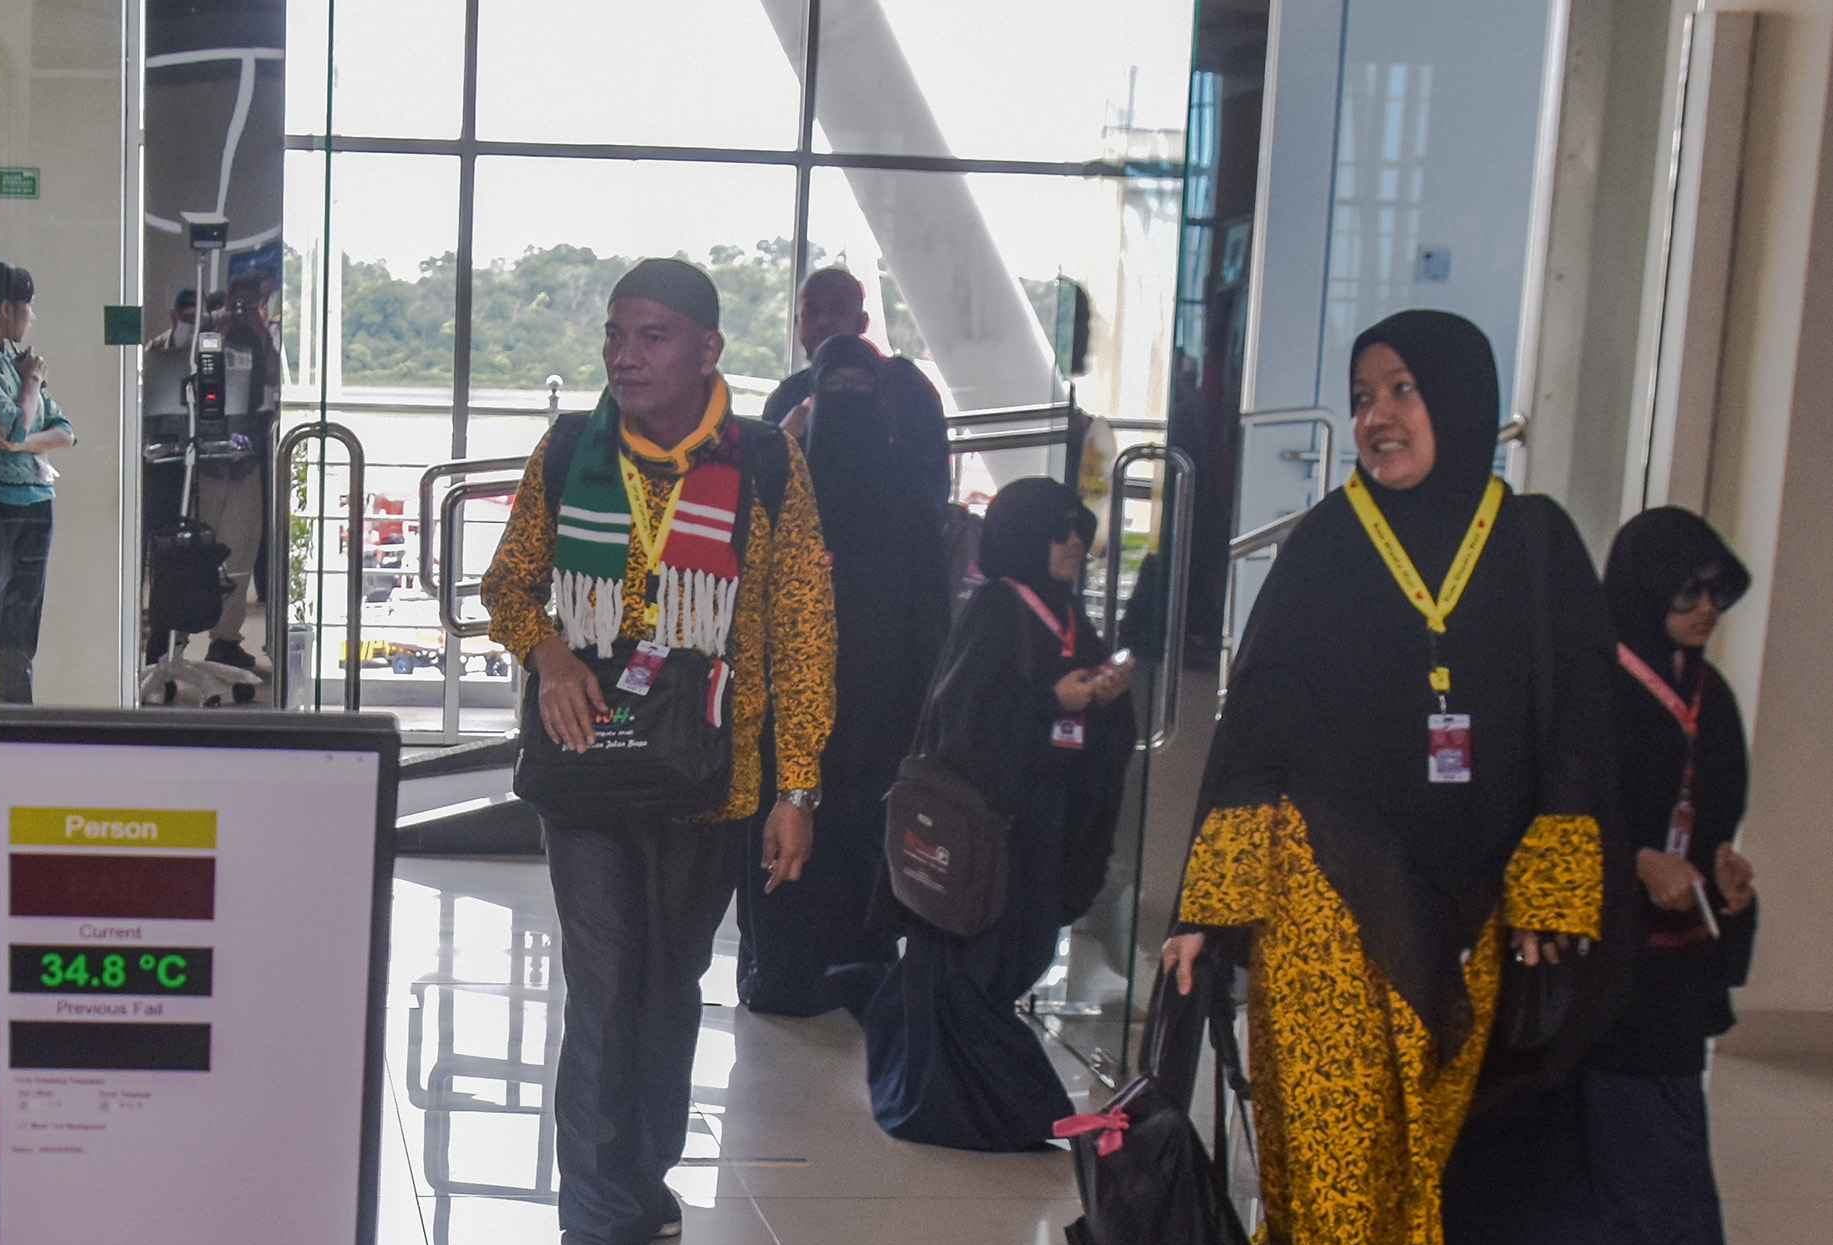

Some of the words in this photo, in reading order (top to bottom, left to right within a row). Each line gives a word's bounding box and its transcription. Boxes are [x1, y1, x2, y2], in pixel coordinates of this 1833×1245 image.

[65, 815, 158, 839] Person
[79, 924, 142, 940] Current
[40, 952, 127, 989] 34.8
[139, 953, 187, 989] °C
[56, 1000, 128, 1016] Previous
[133, 1001, 164, 1016] Fail
